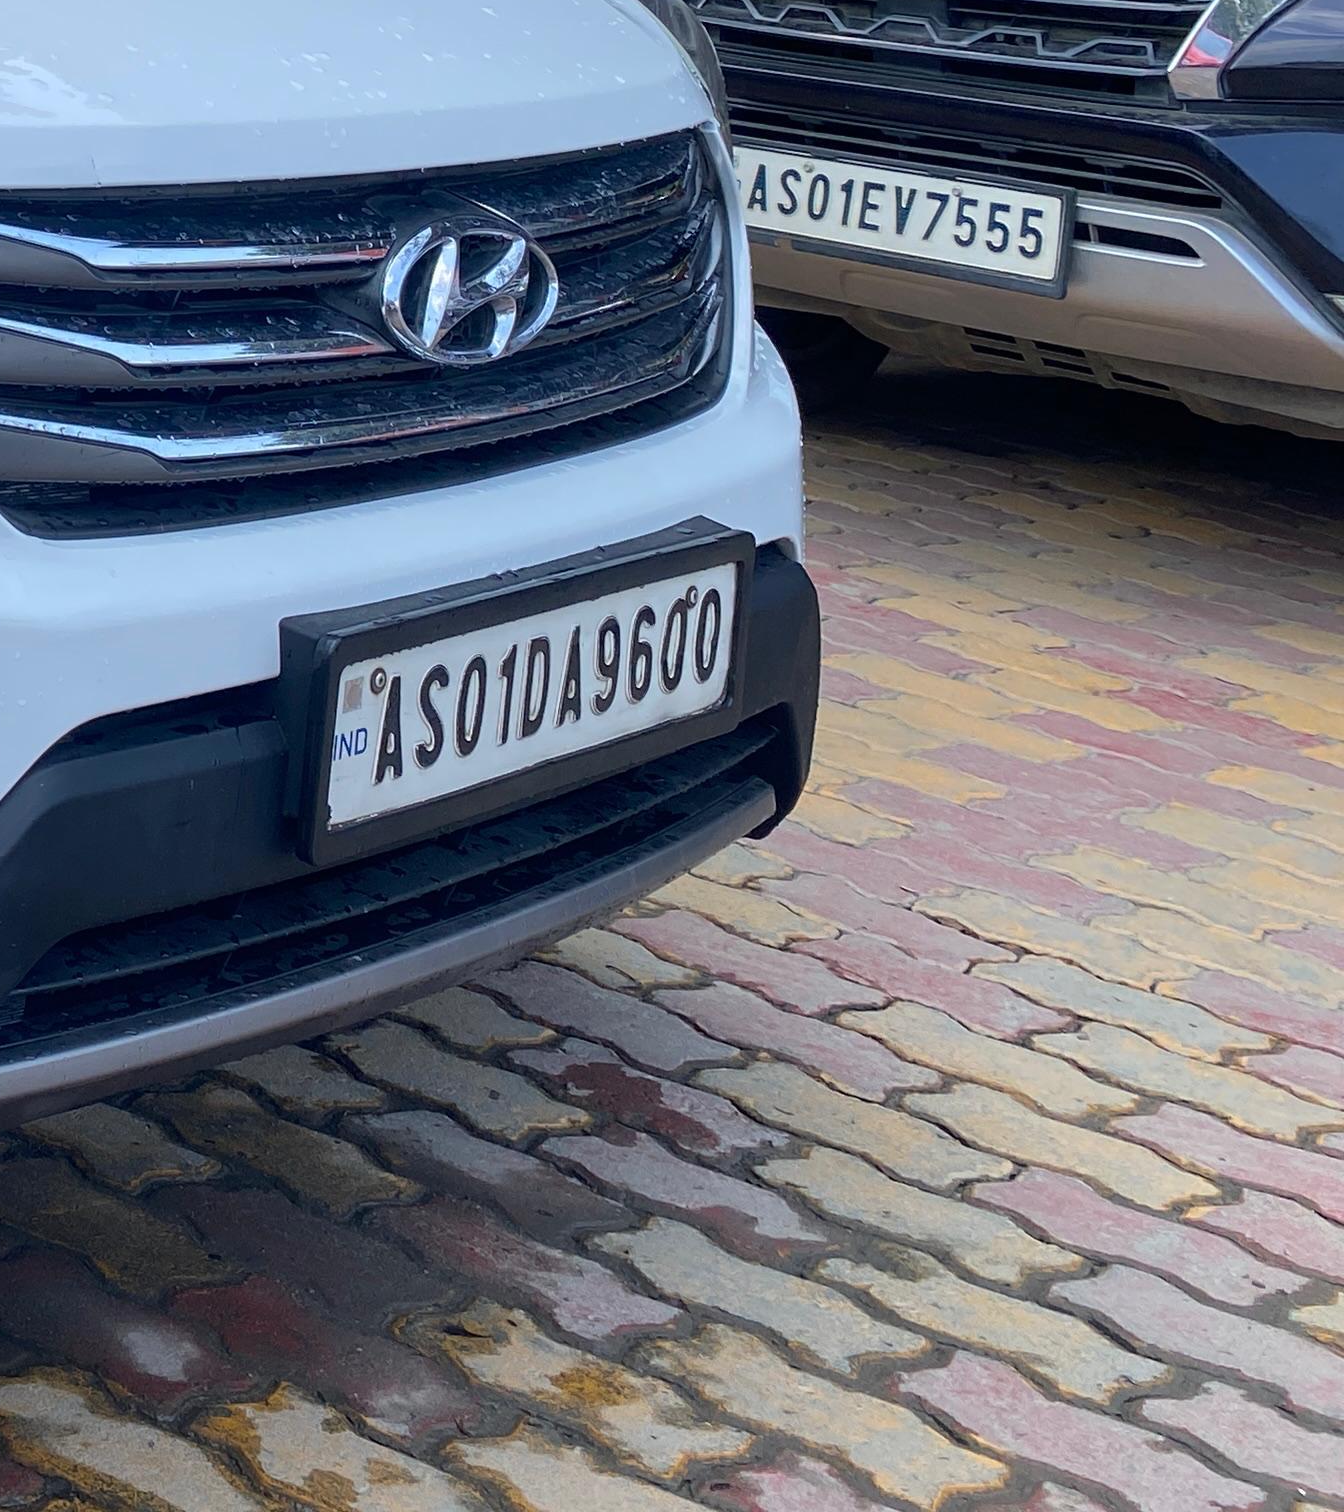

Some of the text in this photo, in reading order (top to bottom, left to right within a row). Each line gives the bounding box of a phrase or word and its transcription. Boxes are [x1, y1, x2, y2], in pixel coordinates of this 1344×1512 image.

[746, 163, 1044, 259] AS01EV7555
[372, 587, 721, 786] AS01DA9600
[333, 727, 368, 761] IND
